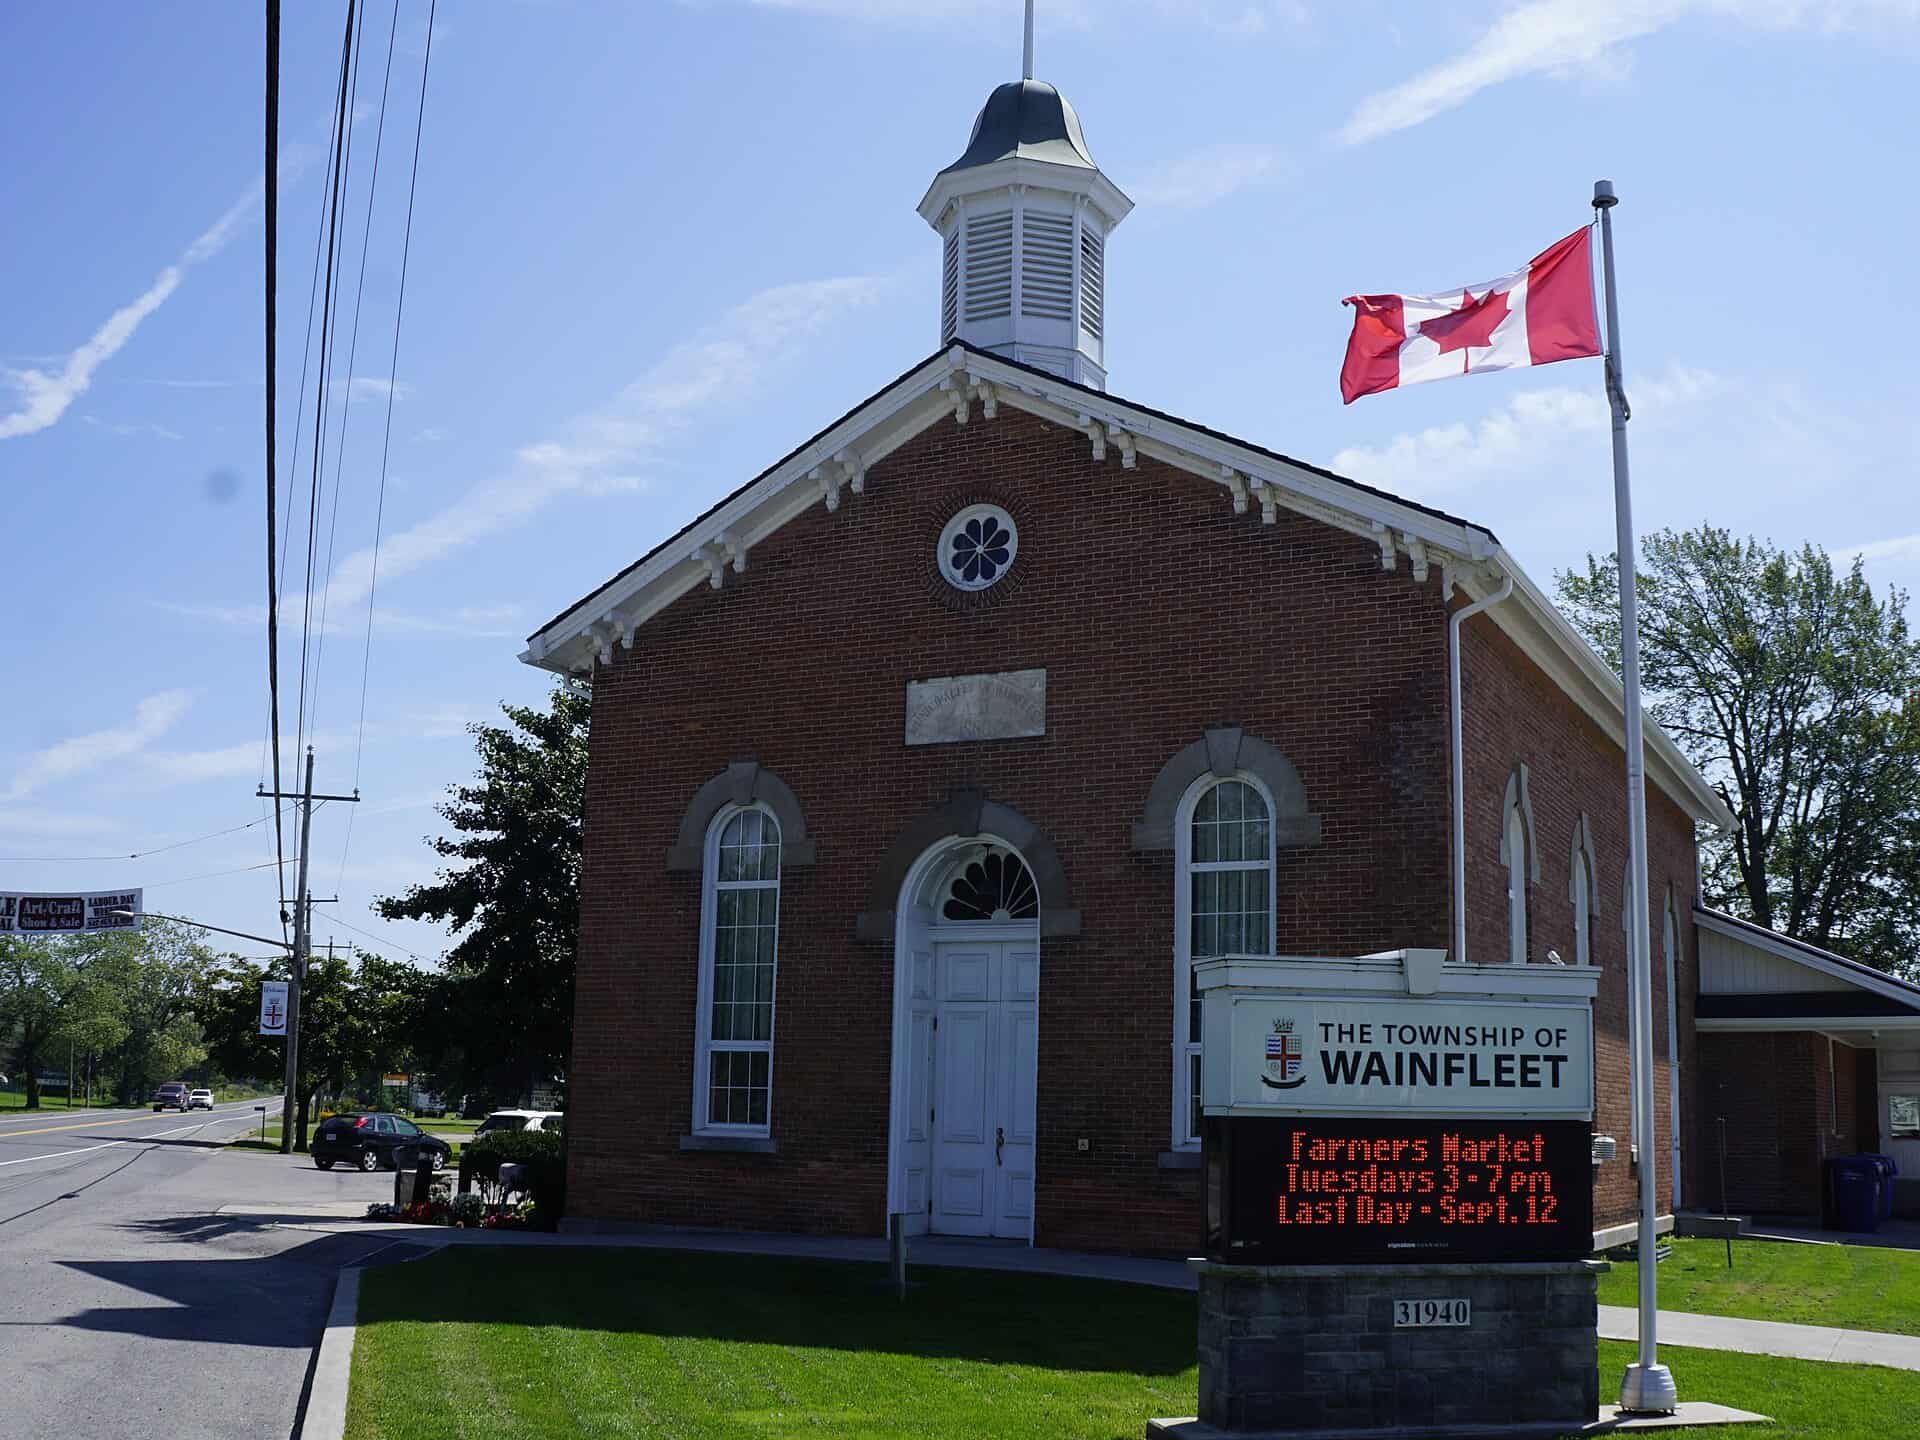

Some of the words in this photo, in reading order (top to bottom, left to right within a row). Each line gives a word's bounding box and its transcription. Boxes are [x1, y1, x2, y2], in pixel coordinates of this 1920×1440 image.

[22, 916, 47, 929] Show
[60, 917, 81, 929] Sale
[1319, 1023, 1372, 1044] THE
[1381, 1024, 1525, 1047] TOWNSHIP
[1535, 1028, 1567, 1048] OF
[1320, 1050, 1568, 1088] WAINFLEET
[1292, 1132, 1429, 1161] Farmers
[1442, 1133, 1544, 1162] Market
[1286, 1164, 1435, 1192] Tuesdays
[1279, 1196, 1348, 1224] Last
[1356, 1196, 1412, 1224] Day
[1396, 1301, 1468, 1325] 31940
